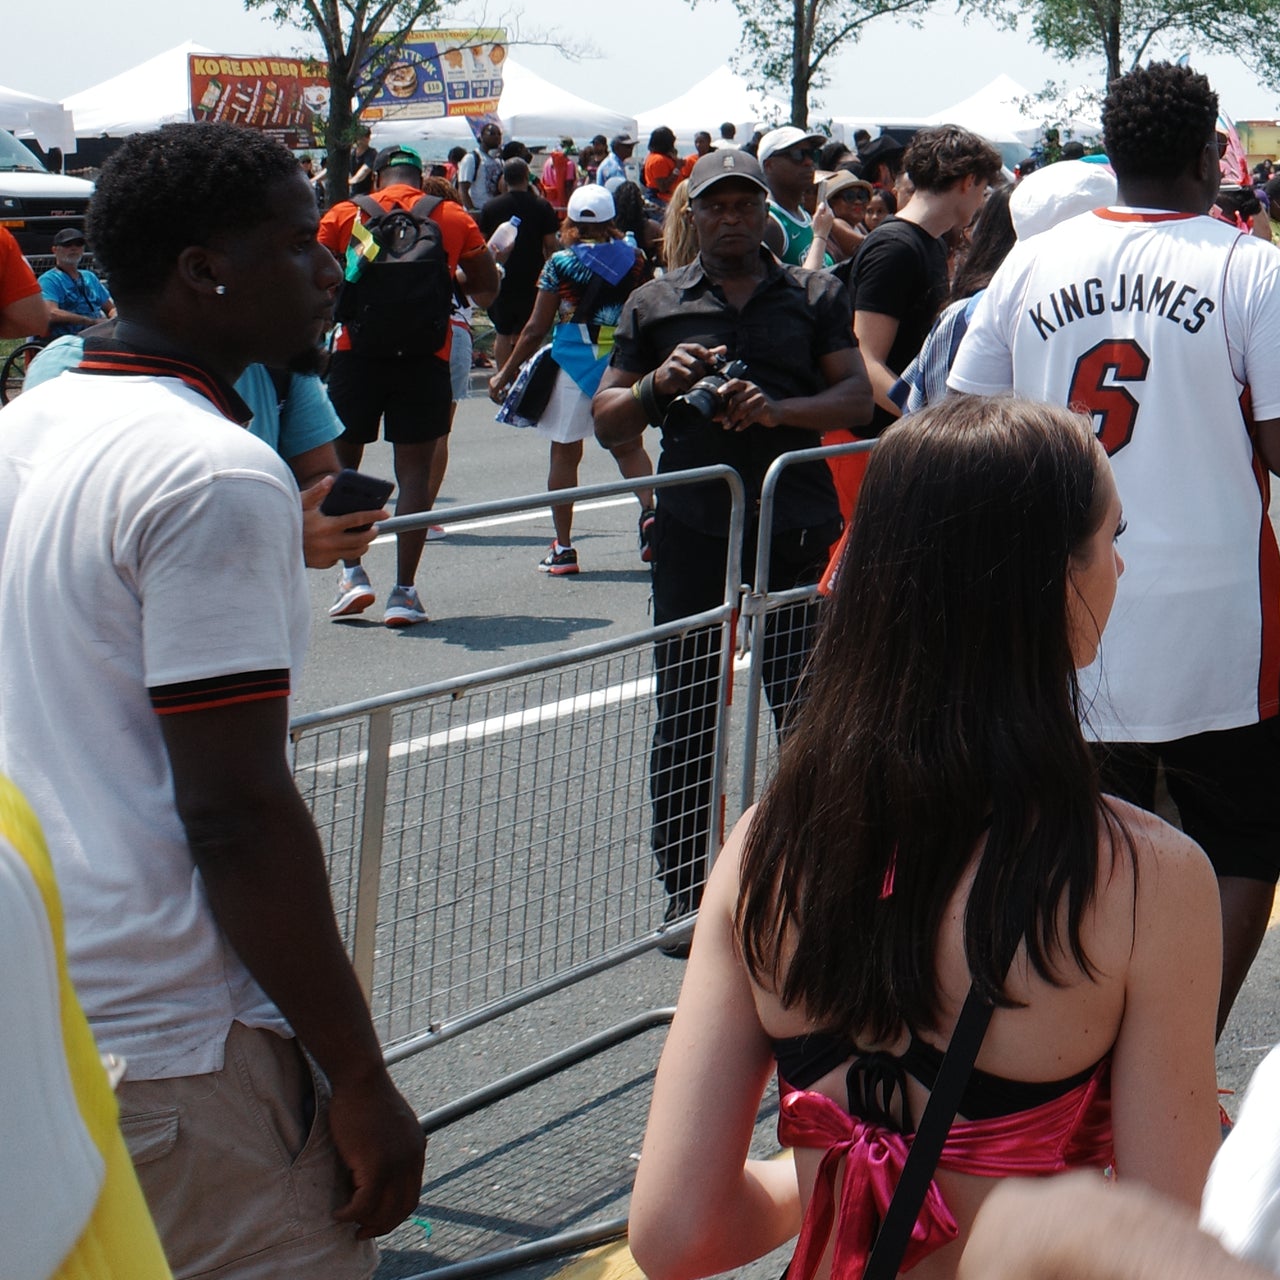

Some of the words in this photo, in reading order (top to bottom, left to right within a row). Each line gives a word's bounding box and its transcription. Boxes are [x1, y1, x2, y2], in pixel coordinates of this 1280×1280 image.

[194, 59, 269, 76] KOREAN
[269, 61, 299, 79] BBQ
[1029, 277, 1105, 341] KING
[1111, 273, 1215, 334] JAMES
[1067, 338, 1151, 458] 6
